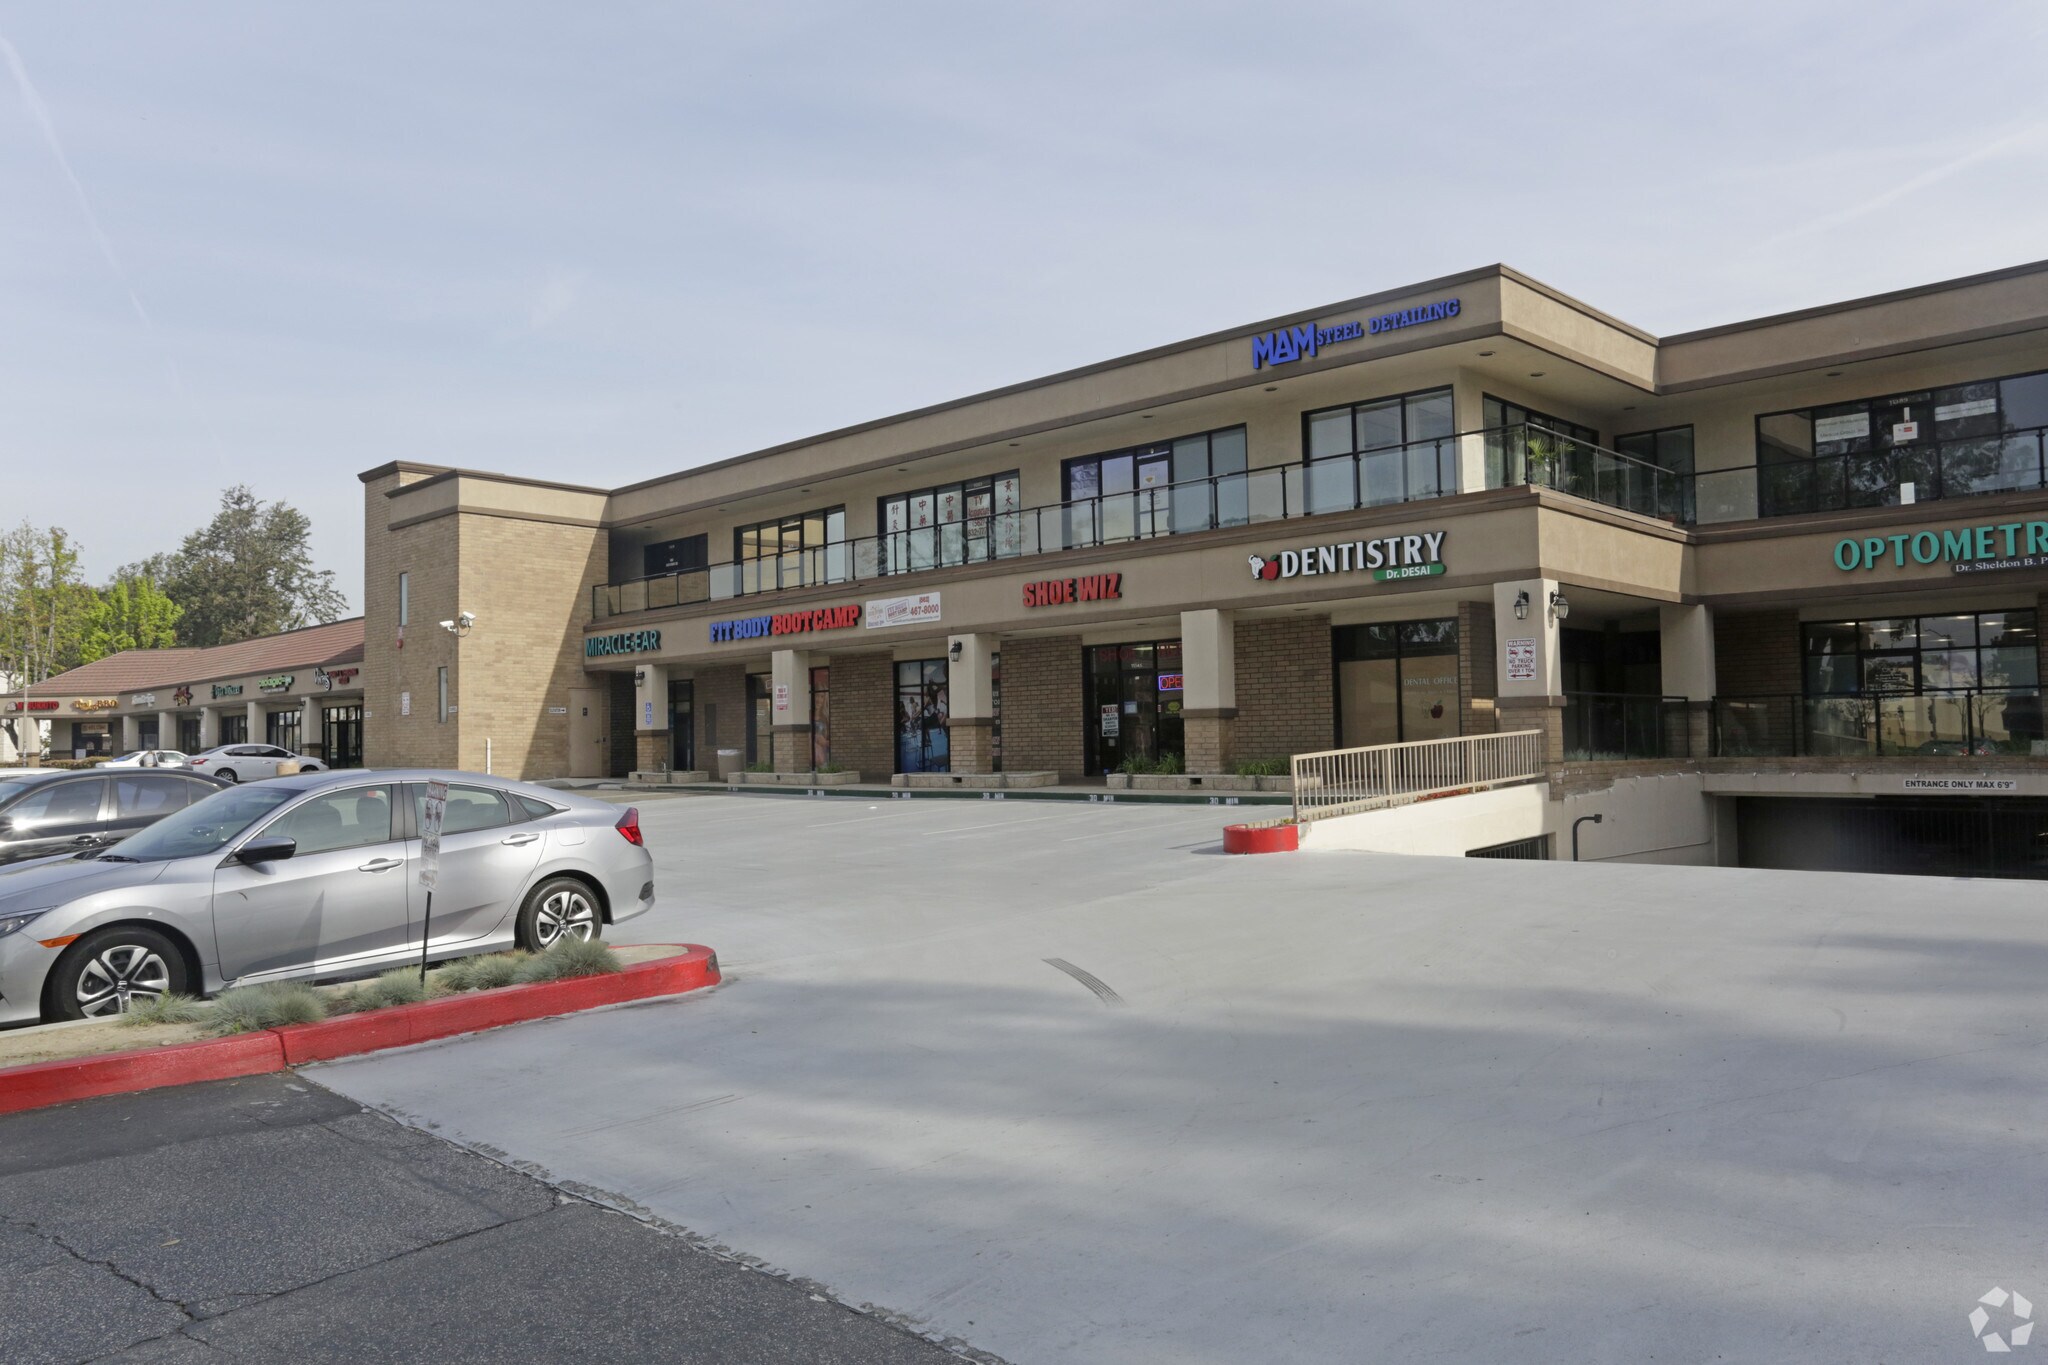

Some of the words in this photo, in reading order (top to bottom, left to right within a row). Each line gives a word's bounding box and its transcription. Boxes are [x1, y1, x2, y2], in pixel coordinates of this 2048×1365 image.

[1252, 322, 1317, 369] MAM
[1317, 321, 1363, 347] STEEL
[1368, 299, 1460, 334] DETAILING
[1281, 531, 1444, 578] DENTISTRY
[1956, 564, 1972, 572] Dr.
[1975, 560, 2020, 571] Sheldon
[2024, 557, 2037, 566] B.
[1386, 569, 1400, 579] Dr.
[1402, 567, 1430, 577] DESAI
[1023, 577, 1076, 607] SHOE
[1078, 572, 1121, 601] WIZ
[710, 621, 734, 642] FIT
[734, 615, 771, 640] BODY
[772, 610, 813, 636] BOOT
[814, 605, 860, 631] CAMP
[586, 630, 659, 657] MIRACLE-EAR
[1508, 639, 1535, 647] WARNING
[1161, 676, 1184, 689] OPE
[1404, 678, 1431, 686] DENTAL
[1905, 780, 1949, 788] ENTRANCE
[1951, 780, 1973, 788] ONLY
[1209, 796, 1218, 805] 30
